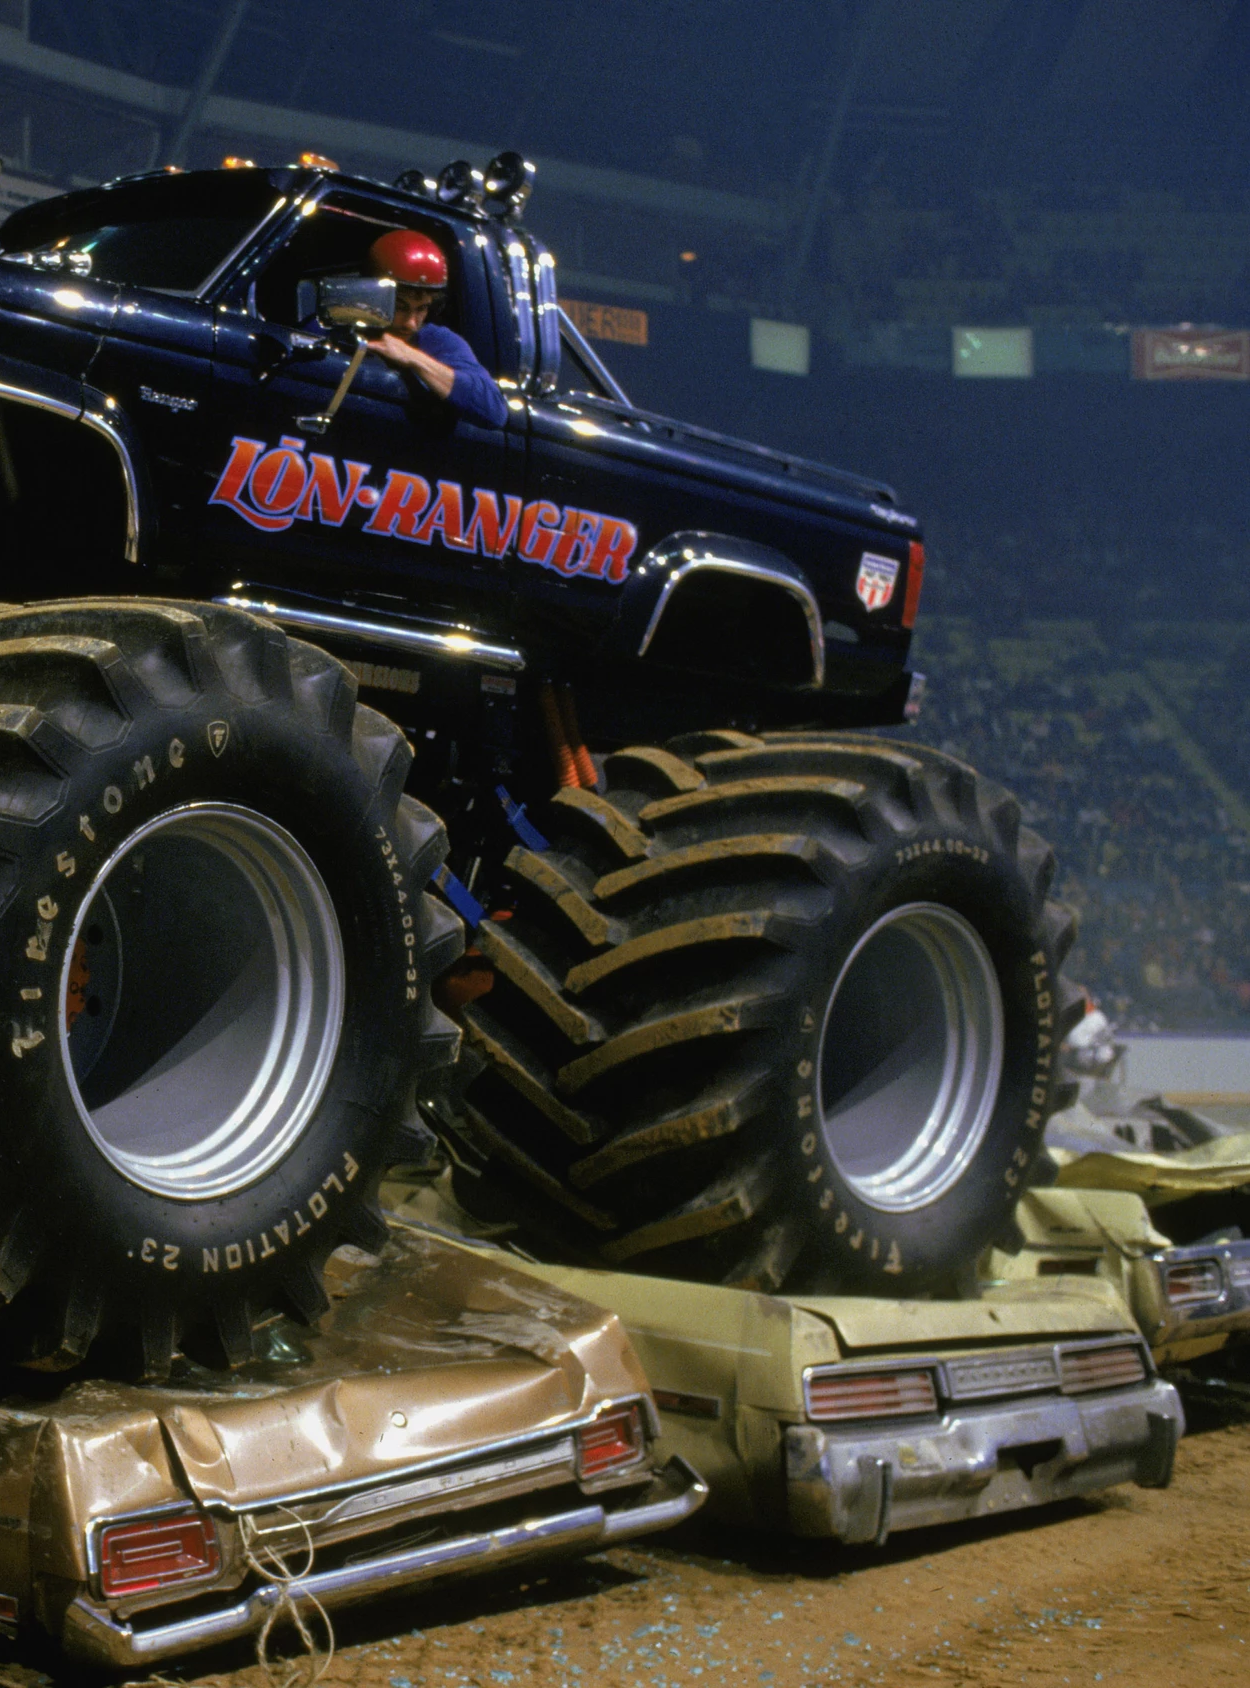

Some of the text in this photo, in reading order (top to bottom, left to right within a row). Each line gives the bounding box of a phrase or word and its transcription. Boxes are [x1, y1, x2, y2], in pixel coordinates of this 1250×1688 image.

[11, 738, 186, 1059] Firestone
[374, 826, 418, 1001] 73X44.00-32
[1025, 950, 1053, 1130] FLOTATION
[202, 1151, 360, 1273] FLOTATION
[796, 1058, 903, 1275] Firestone
